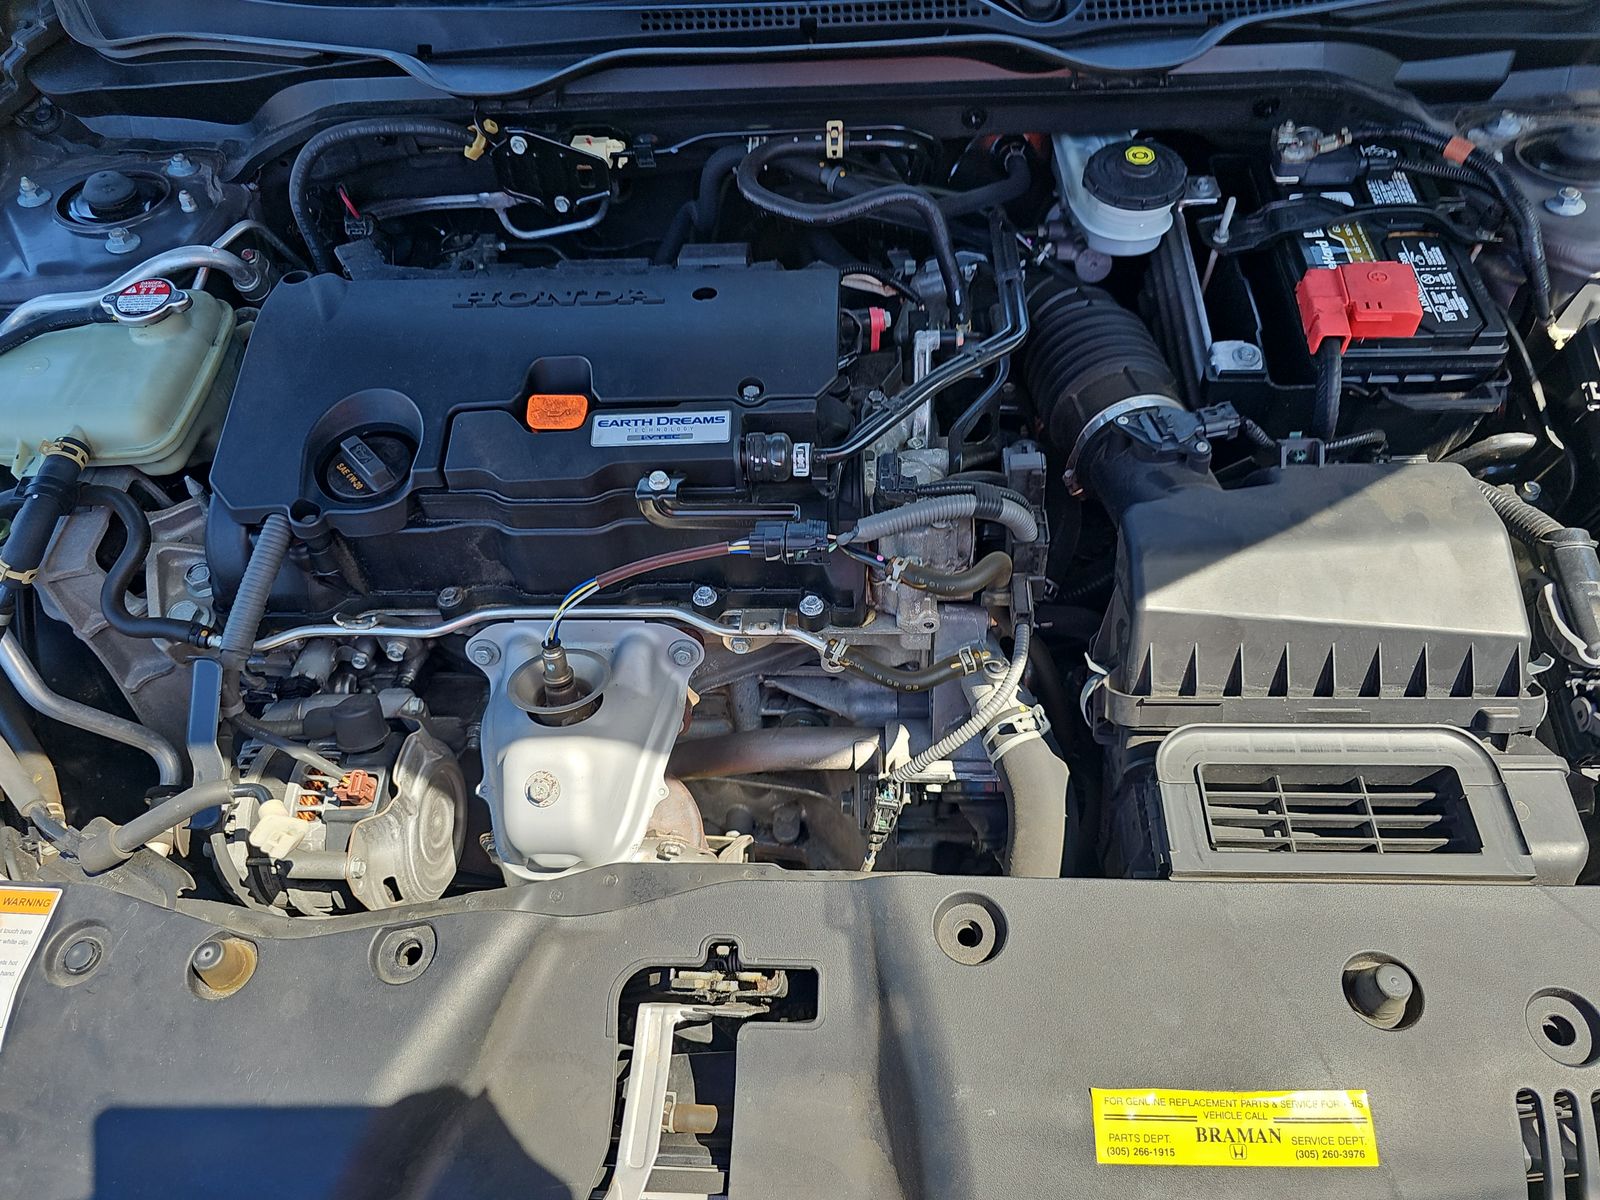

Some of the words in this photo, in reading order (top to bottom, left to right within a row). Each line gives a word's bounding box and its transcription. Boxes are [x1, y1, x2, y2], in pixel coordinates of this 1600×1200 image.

[452, 290, 666, 308] HONDA
[597, 418, 653, 428] EARTH
[656, 415, 726, 426] DREAMS
[336, 462, 351, 476] SAE
[3, 897, 51, 908] WARNING
[1104, 1097, 1123, 1106] FOR
[1126, 1097, 1166, 1106] GENUNE
[1169, 1098, 1237, 1108] REPLACEMENT
[1241, 1100, 1269, 1108] PARTS
[1280, 1100, 1318, 1109] SERVICE
[1321, 1100, 1340, 1108] FOR
[1344, 1100, 1364, 1109] HIS
[1203, 1111, 1242, 1120] VEHICLE
[1245, 1111, 1268, 1120] CALL
[1108, 1133, 1141, 1143] PARTS
[1143, 1134, 1172, 1144] DEPT.
[1196, 1127, 1282, 1144] BRAMAN
[1291, 1136, 1335, 1146] SERVICE
[1338, 1137, 1367, 1146] DEPT.
[1106, 1147, 1130, 1157] (305)
[1133, 1147, 1176, 1157] 266-1915
[1295, 1150, 1319, 1160] (305)
[1322, 1150, 1366, 1160] 260-3976
